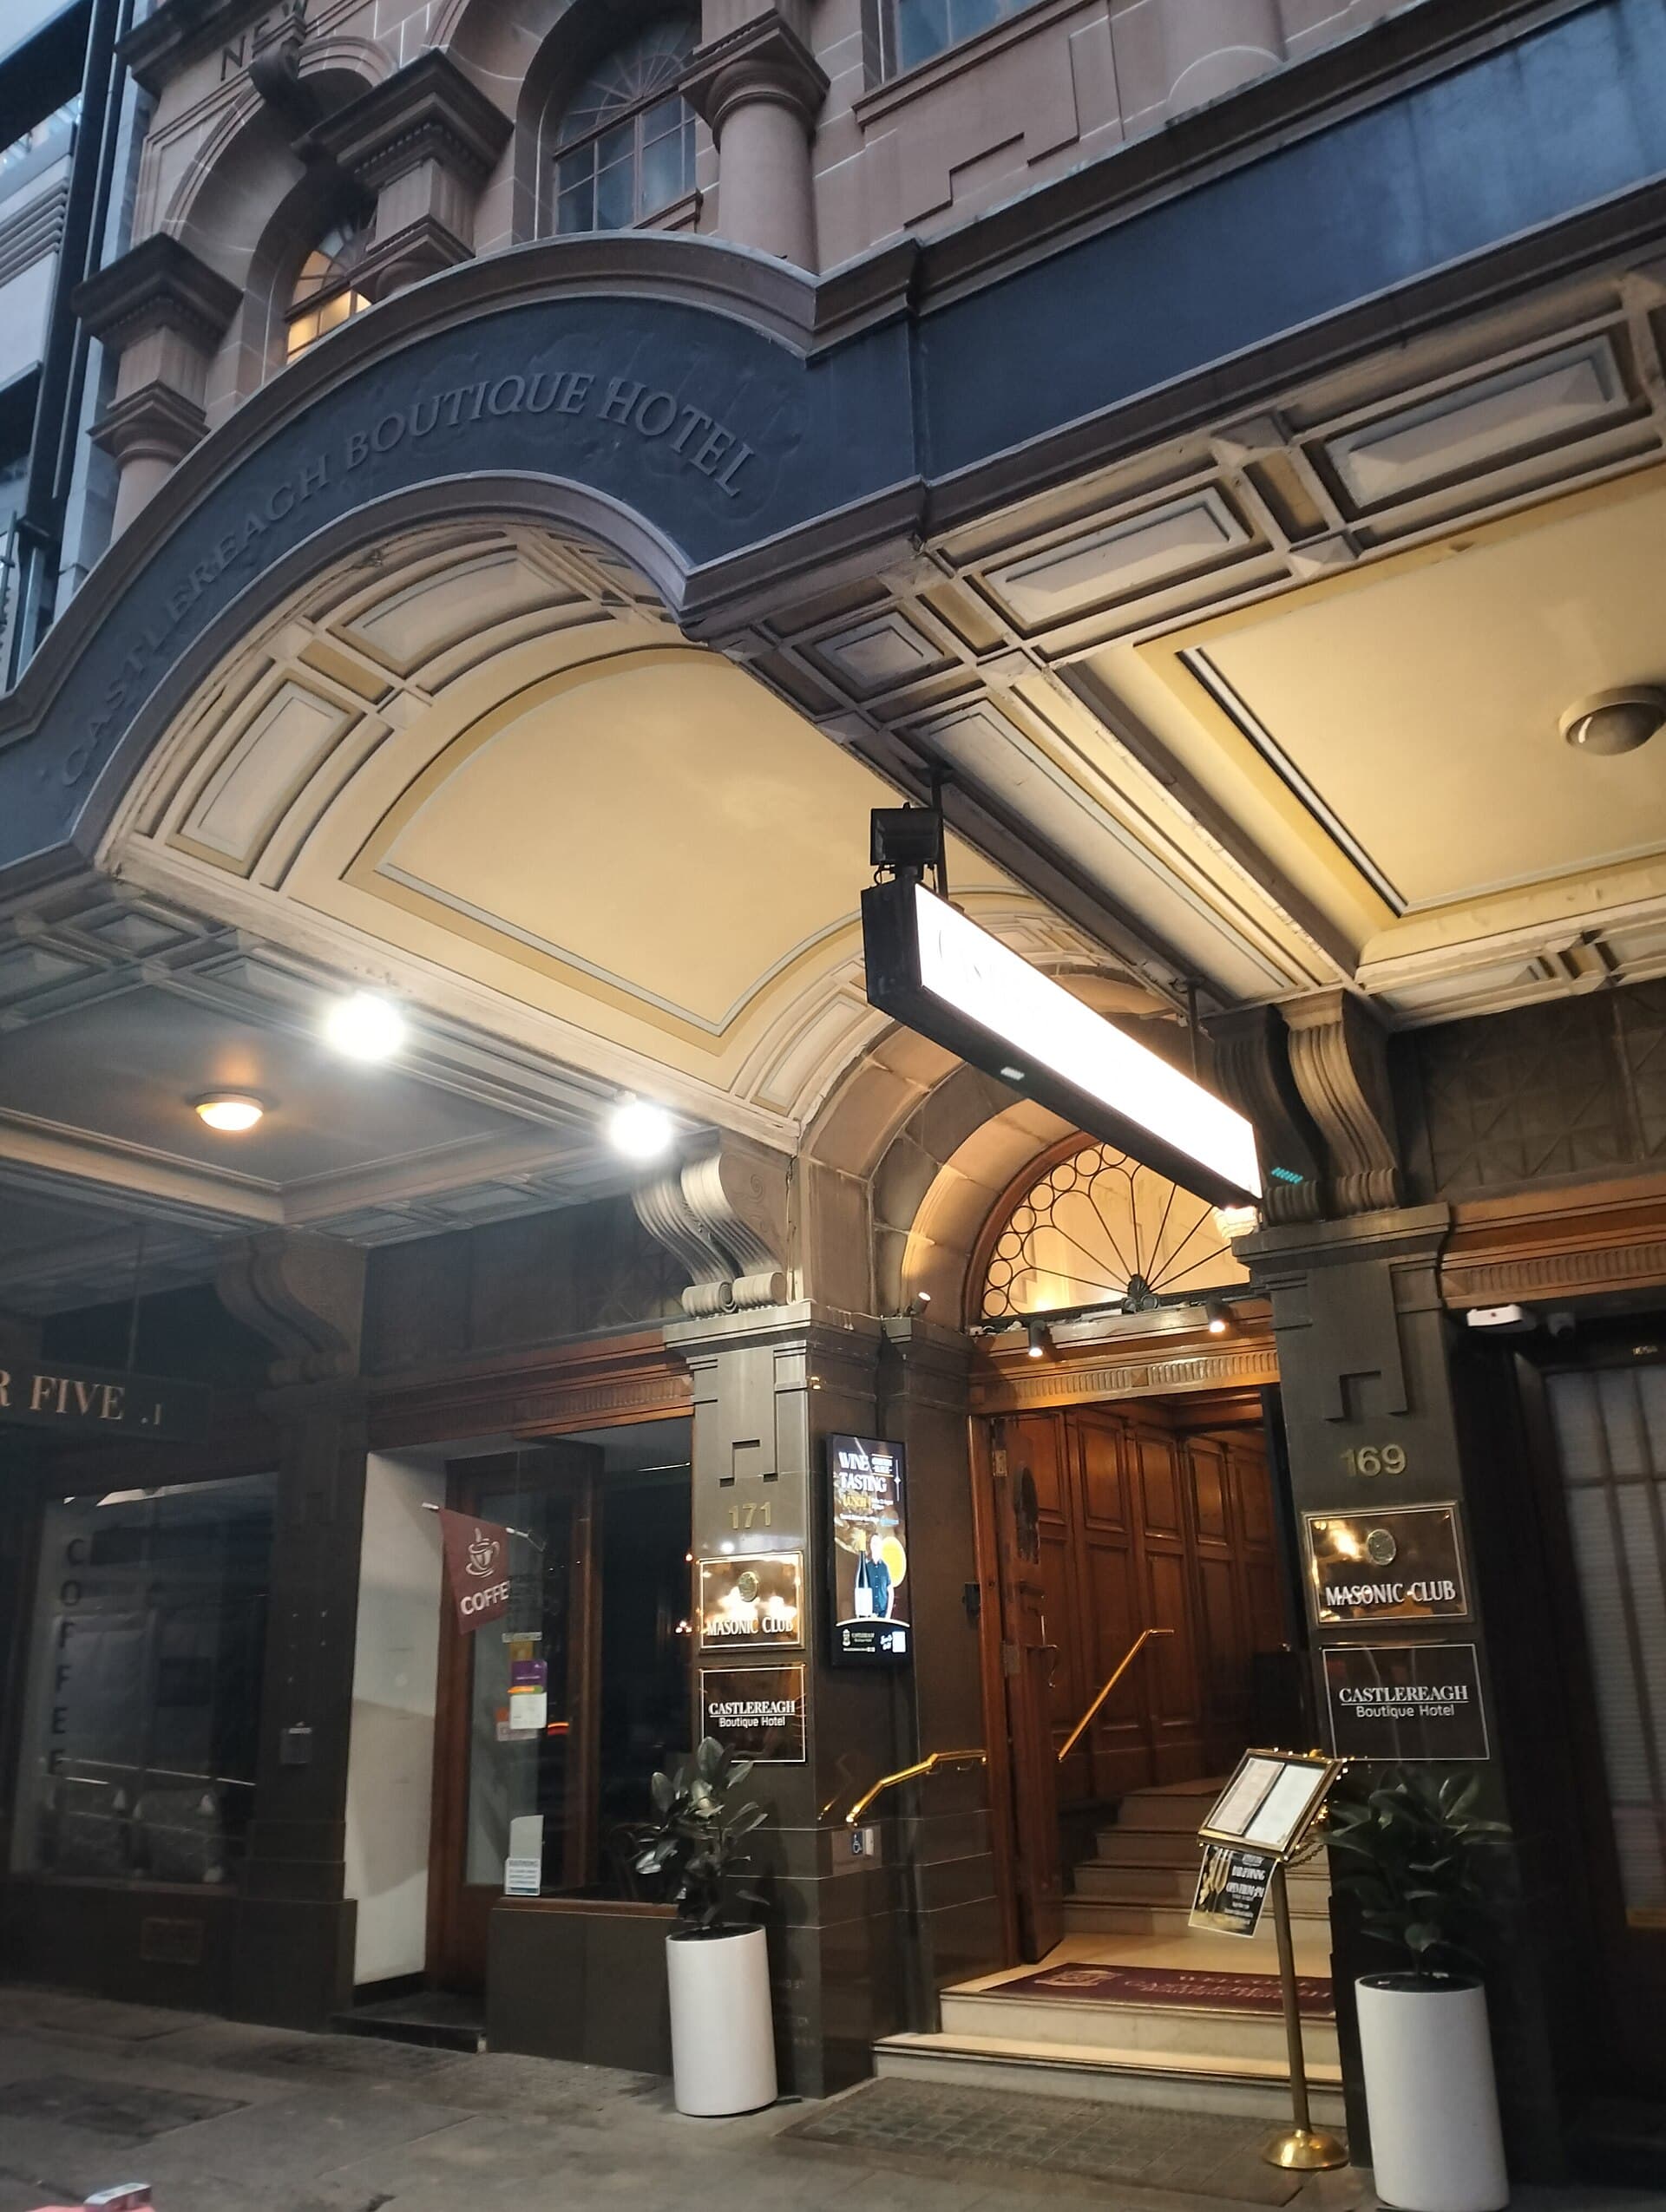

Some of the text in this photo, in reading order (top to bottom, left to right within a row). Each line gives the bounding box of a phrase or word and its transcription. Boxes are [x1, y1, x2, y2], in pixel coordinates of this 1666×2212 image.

[62, 370, 756, 786] CASTLEREAGH BOUTIQUE HOTEL
[29, 1375, 126, 1420] FIVE
[838, 1451, 869, 1472] WINE
[1341, 1443, 1407, 1476] 169
[838, 1471, 888, 1493] TASTING
[728, 1501, 773, 1530] 171
[460, 1580, 511, 1615] COFFE
[1325, 1580, 1457, 1606] MASONIC CLUB
[705, 1615, 795, 1637] MASONIC CLUB
[47, 1537, 85, 1776] COFFEE
[1339, 1685, 1469, 1704] CASTLEREAGH
[708, 1699, 796, 1716] CASTLEREAGH
[1356, 1704, 1455, 1719] Boutique Hotel
[718, 1716, 786, 1729] Boutique Hotel
